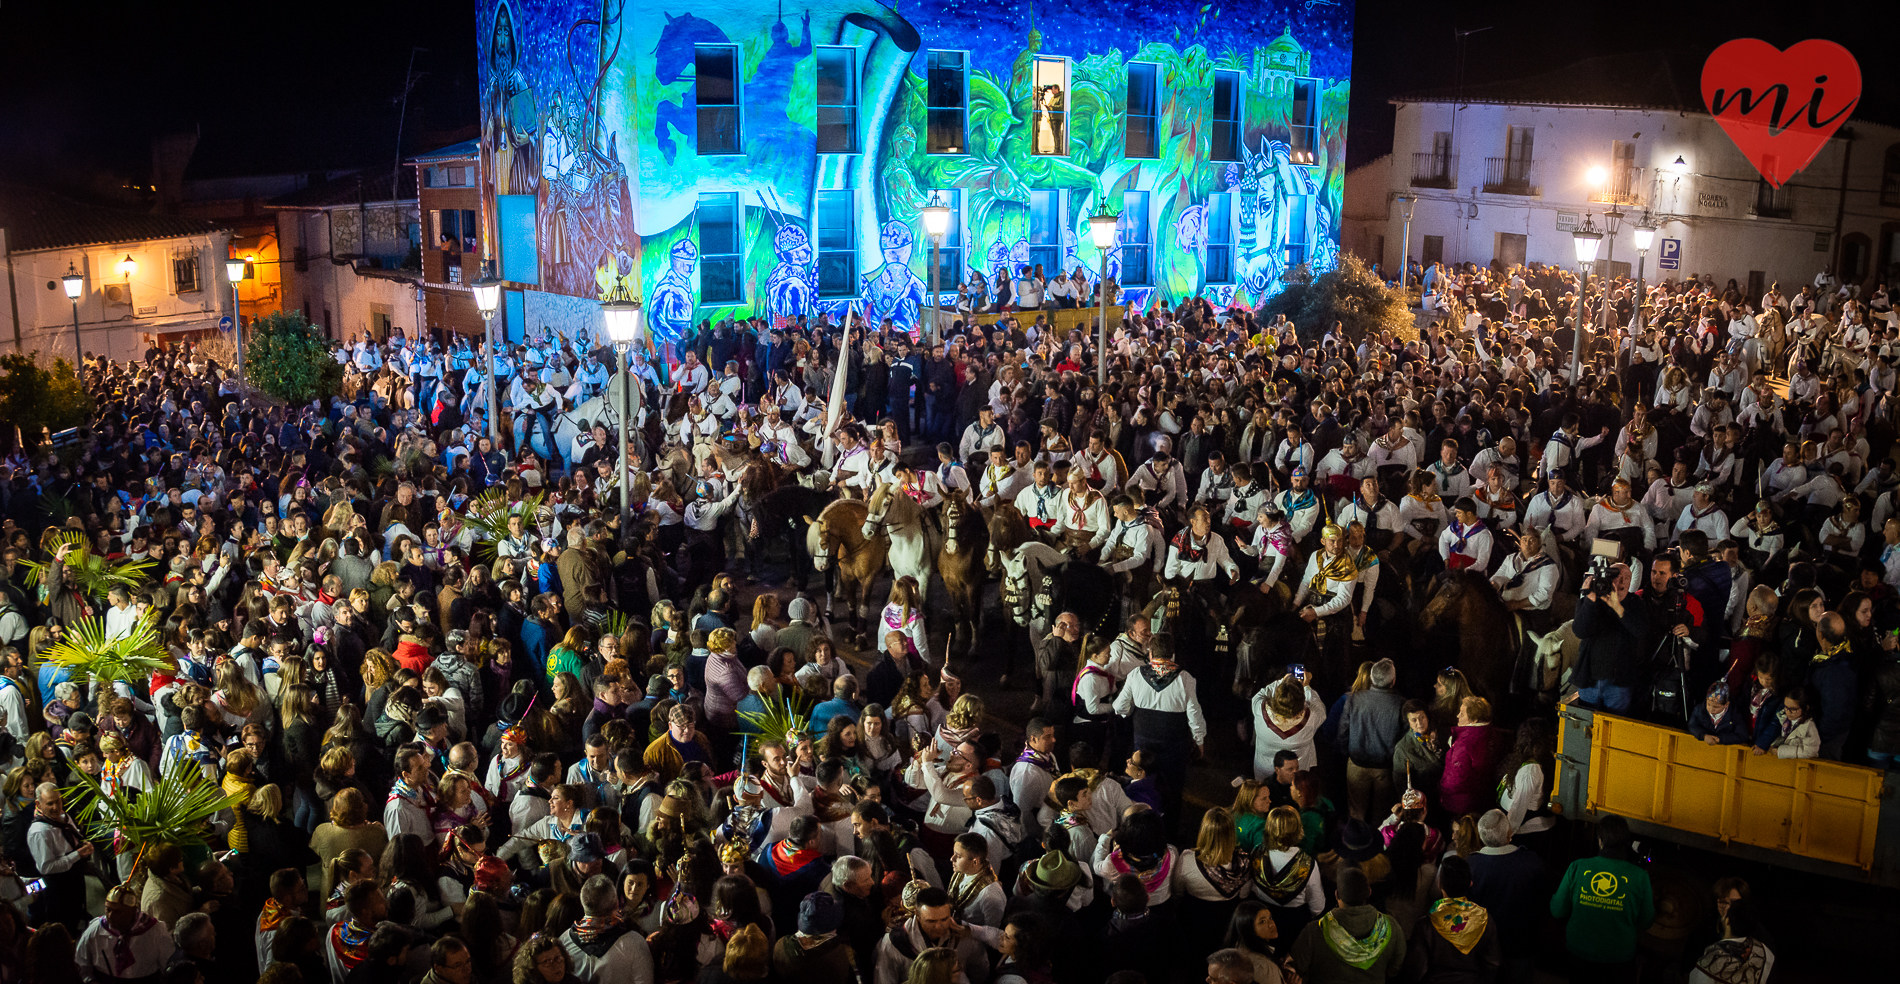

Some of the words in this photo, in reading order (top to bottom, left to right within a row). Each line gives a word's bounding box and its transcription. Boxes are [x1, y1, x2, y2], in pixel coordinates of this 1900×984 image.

[1700, 193, 1727, 201] MORENO
[1663, 240, 1678, 257] P
[1580, 893, 1623, 906] PHOTODIGITAL
